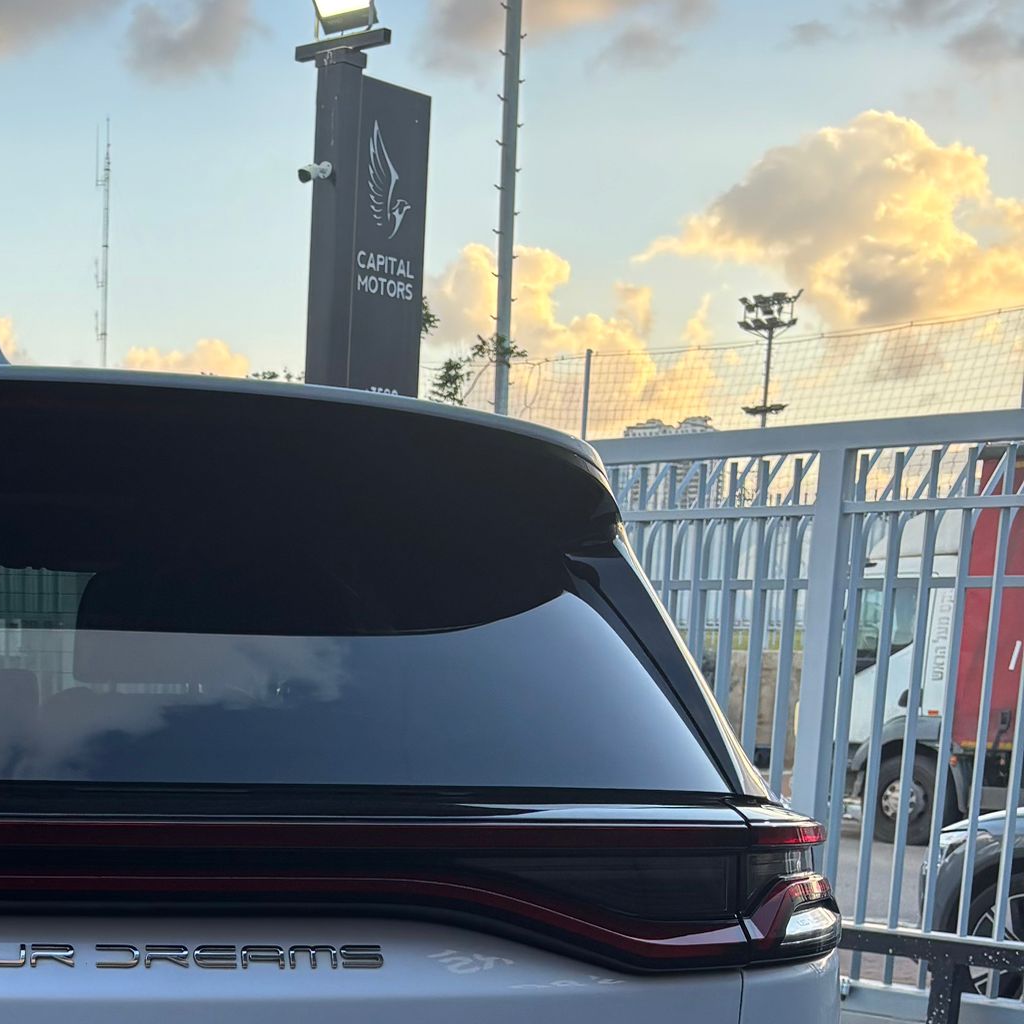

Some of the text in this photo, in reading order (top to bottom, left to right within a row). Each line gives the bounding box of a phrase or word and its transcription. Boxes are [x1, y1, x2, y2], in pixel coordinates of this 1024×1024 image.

[356, 249, 415, 280] CAPITAL
[357, 274, 413, 301] MOTORS
[95, 944, 385, 970] DREAMS
